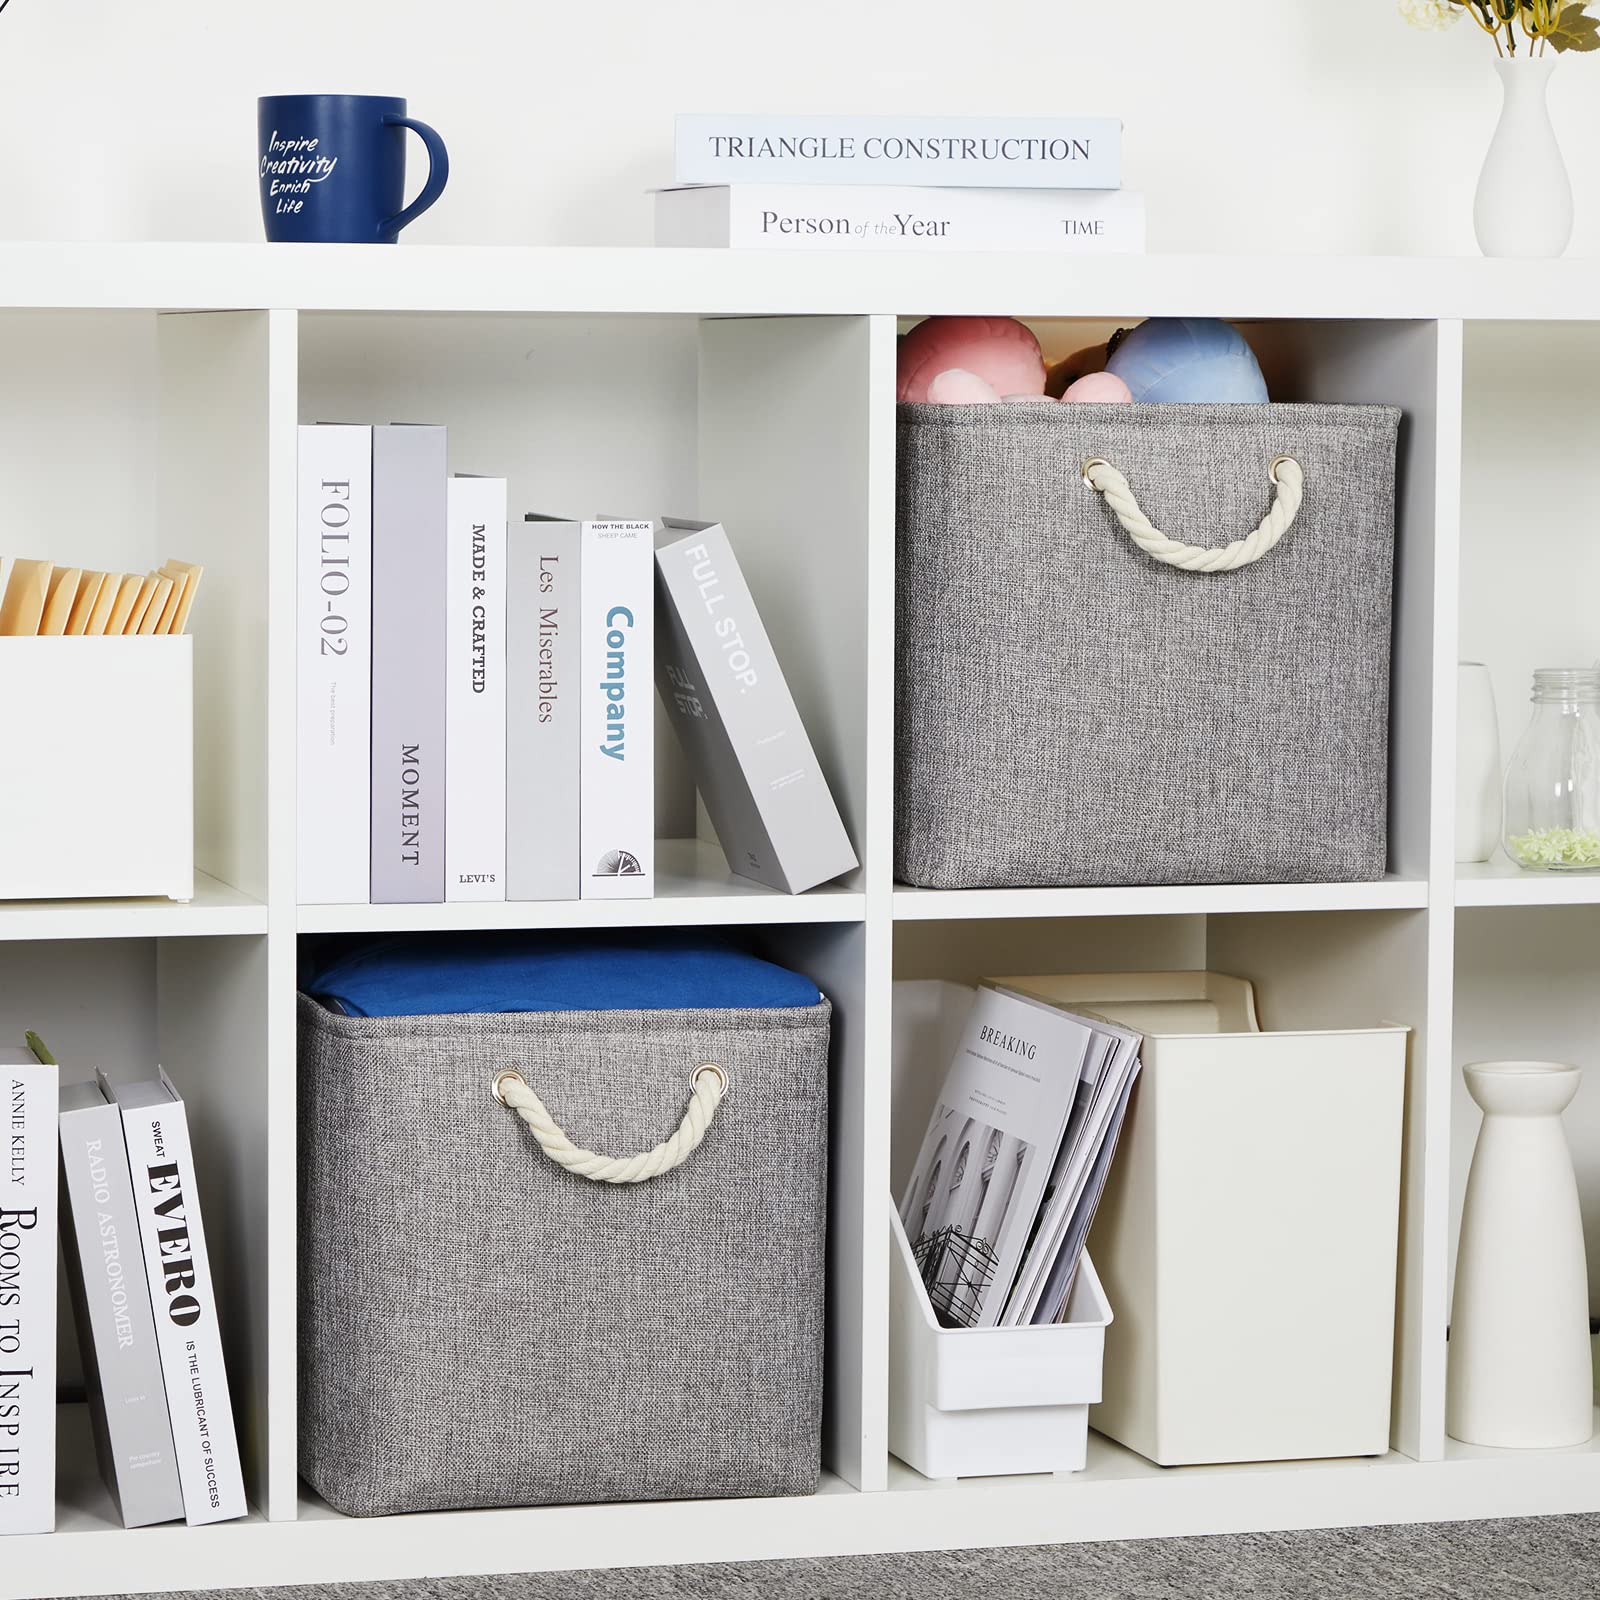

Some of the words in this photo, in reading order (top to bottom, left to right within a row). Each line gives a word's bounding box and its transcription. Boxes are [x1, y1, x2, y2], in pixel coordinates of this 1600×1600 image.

[269, 130, 319, 156] Inspire
[709, 135, 856, 160] TRIANGLE
[863, 136, 1091, 162] CONSTRUCTION
[260, 155, 338, 182] Creativity
[270, 179, 311, 196] Enrich
[276, 199, 304, 214] Life
[761, 210, 851, 235] Person
[854, 220, 870, 239] of
[893, 213, 951, 237] Year
[1061, 218, 1105, 236] TIME
[320, 478, 350, 656] FOLIO-02
[471, 523, 486, 582] MADE
[538, 554, 559, 593] Les
[684, 542, 725, 615] FULL
[471, 586, 486, 601] &
[471, 604, 486, 694] CRAFTED
[538, 607, 559, 724] Miserables
[600, 605, 634, 762] Company
[401, 743, 420, 866] MOMENT
[459, 873, 496, 884] LEVI'S
[979, 1024, 1037, 1061] BREAKING
[11, 1079, 25, 1130] ANNIE
[150, 1120, 166, 1158] SWEAT
[11, 1135, 25, 1186] KELLY
[86, 1138, 110, 1205] RADIO
[146, 1159, 201, 1327] EVERO
[97, 1211, 134, 1351] ASTRONOMER
[186, 1340, 196, 1352] IS
[187, 1352, 200, 1375] THE
[191, 1376, 210, 1438] LUBRICANT
[201, 1439, 212, 1455] OF
[204, 1456, 220, 1509] SUCCESS
